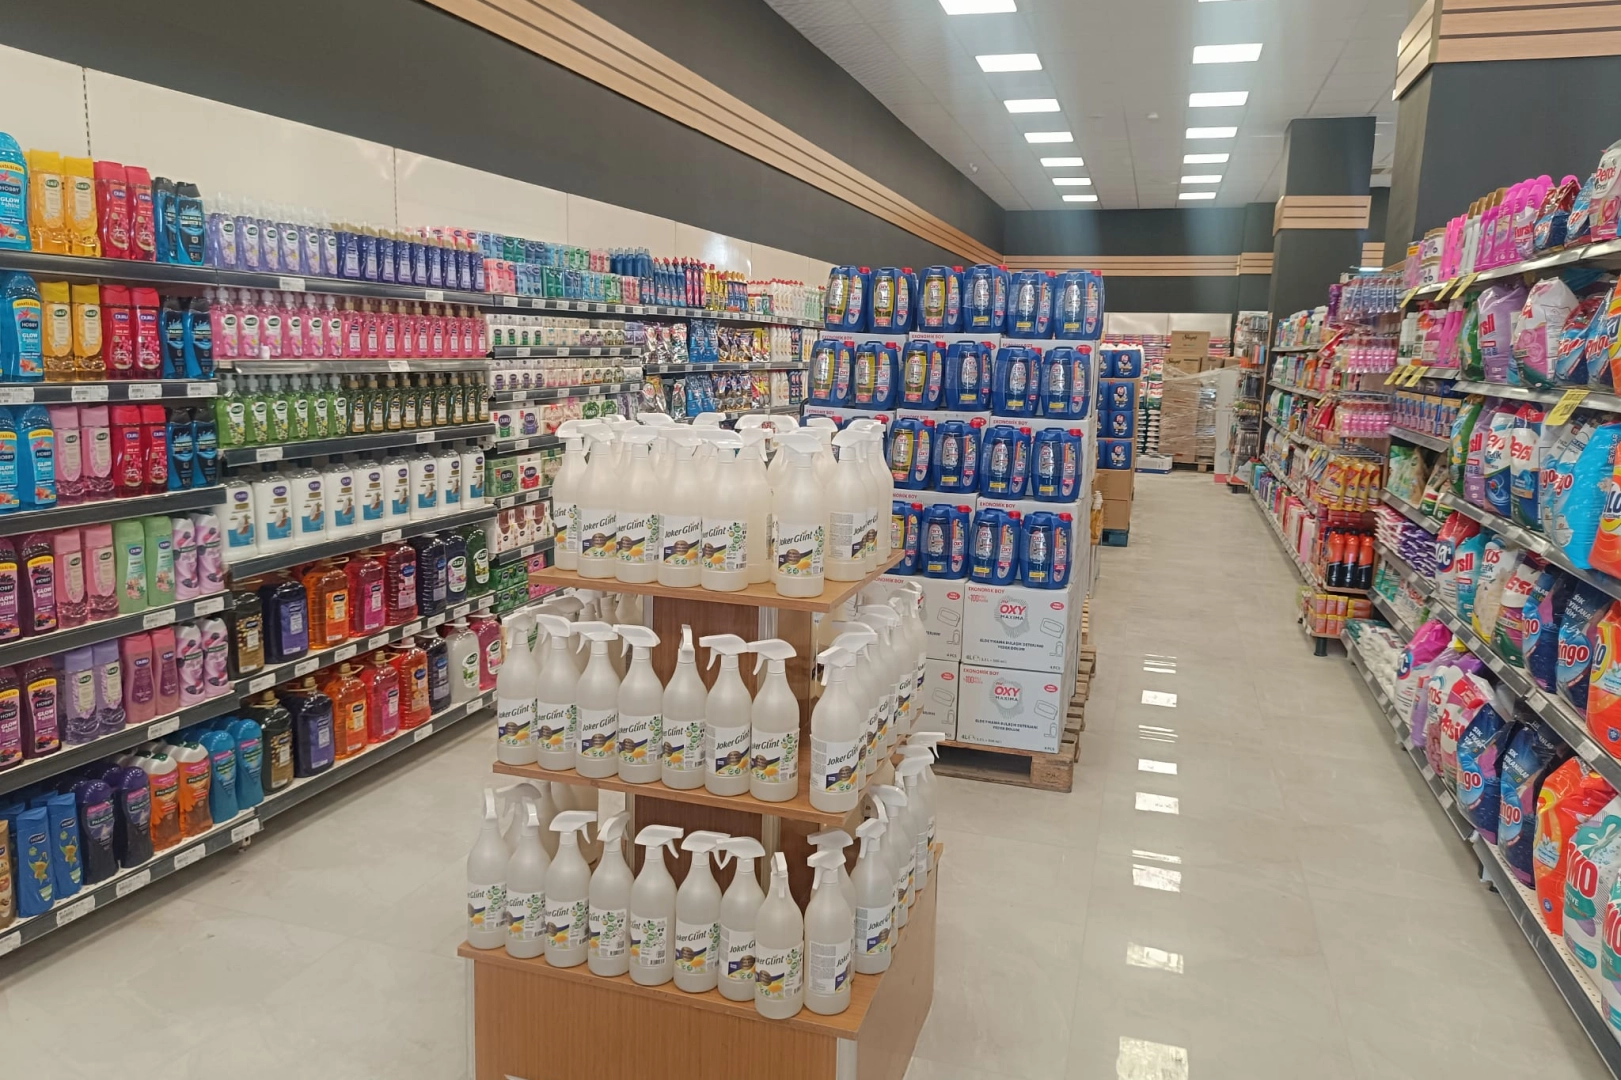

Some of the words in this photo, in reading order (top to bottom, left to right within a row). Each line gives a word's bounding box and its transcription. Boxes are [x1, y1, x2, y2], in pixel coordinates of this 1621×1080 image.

[582, 521, 599, 532] Joker
[600, 513, 616, 527] Glint
[626, 519, 644, 530] Glint
[664, 528, 682, 539] Joker
[682, 521, 699, 534] Glint
[708, 526, 726, 538] Glint
[793, 531, 813, 543] Glint
[1000, 604, 1026, 615] OXY
[994, 686, 1020, 697] OXY
[511, 704, 529, 716] Glint
[546, 709, 563, 720] Glint
[582, 721, 599, 731] Joker
[599, 714, 616, 727] Glint
[628, 721, 647, 732] Glint
[667, 727, 684, 737] Glint
[716, 739, 734, 750] Joker
[761, 739, 780, 749] Glint
[827, 753, 846, 766] Joker
[470, 889, 485, 899] Glint
[509, 897, 524, 907] Glint
[552, 906, 569, 918] Glint
[867, 917, 884, 931] Joker
[688, 929, 707, 941] Glint
[729, 942, 748, 954] Joker
[765, 954, 784, 966] Glint
